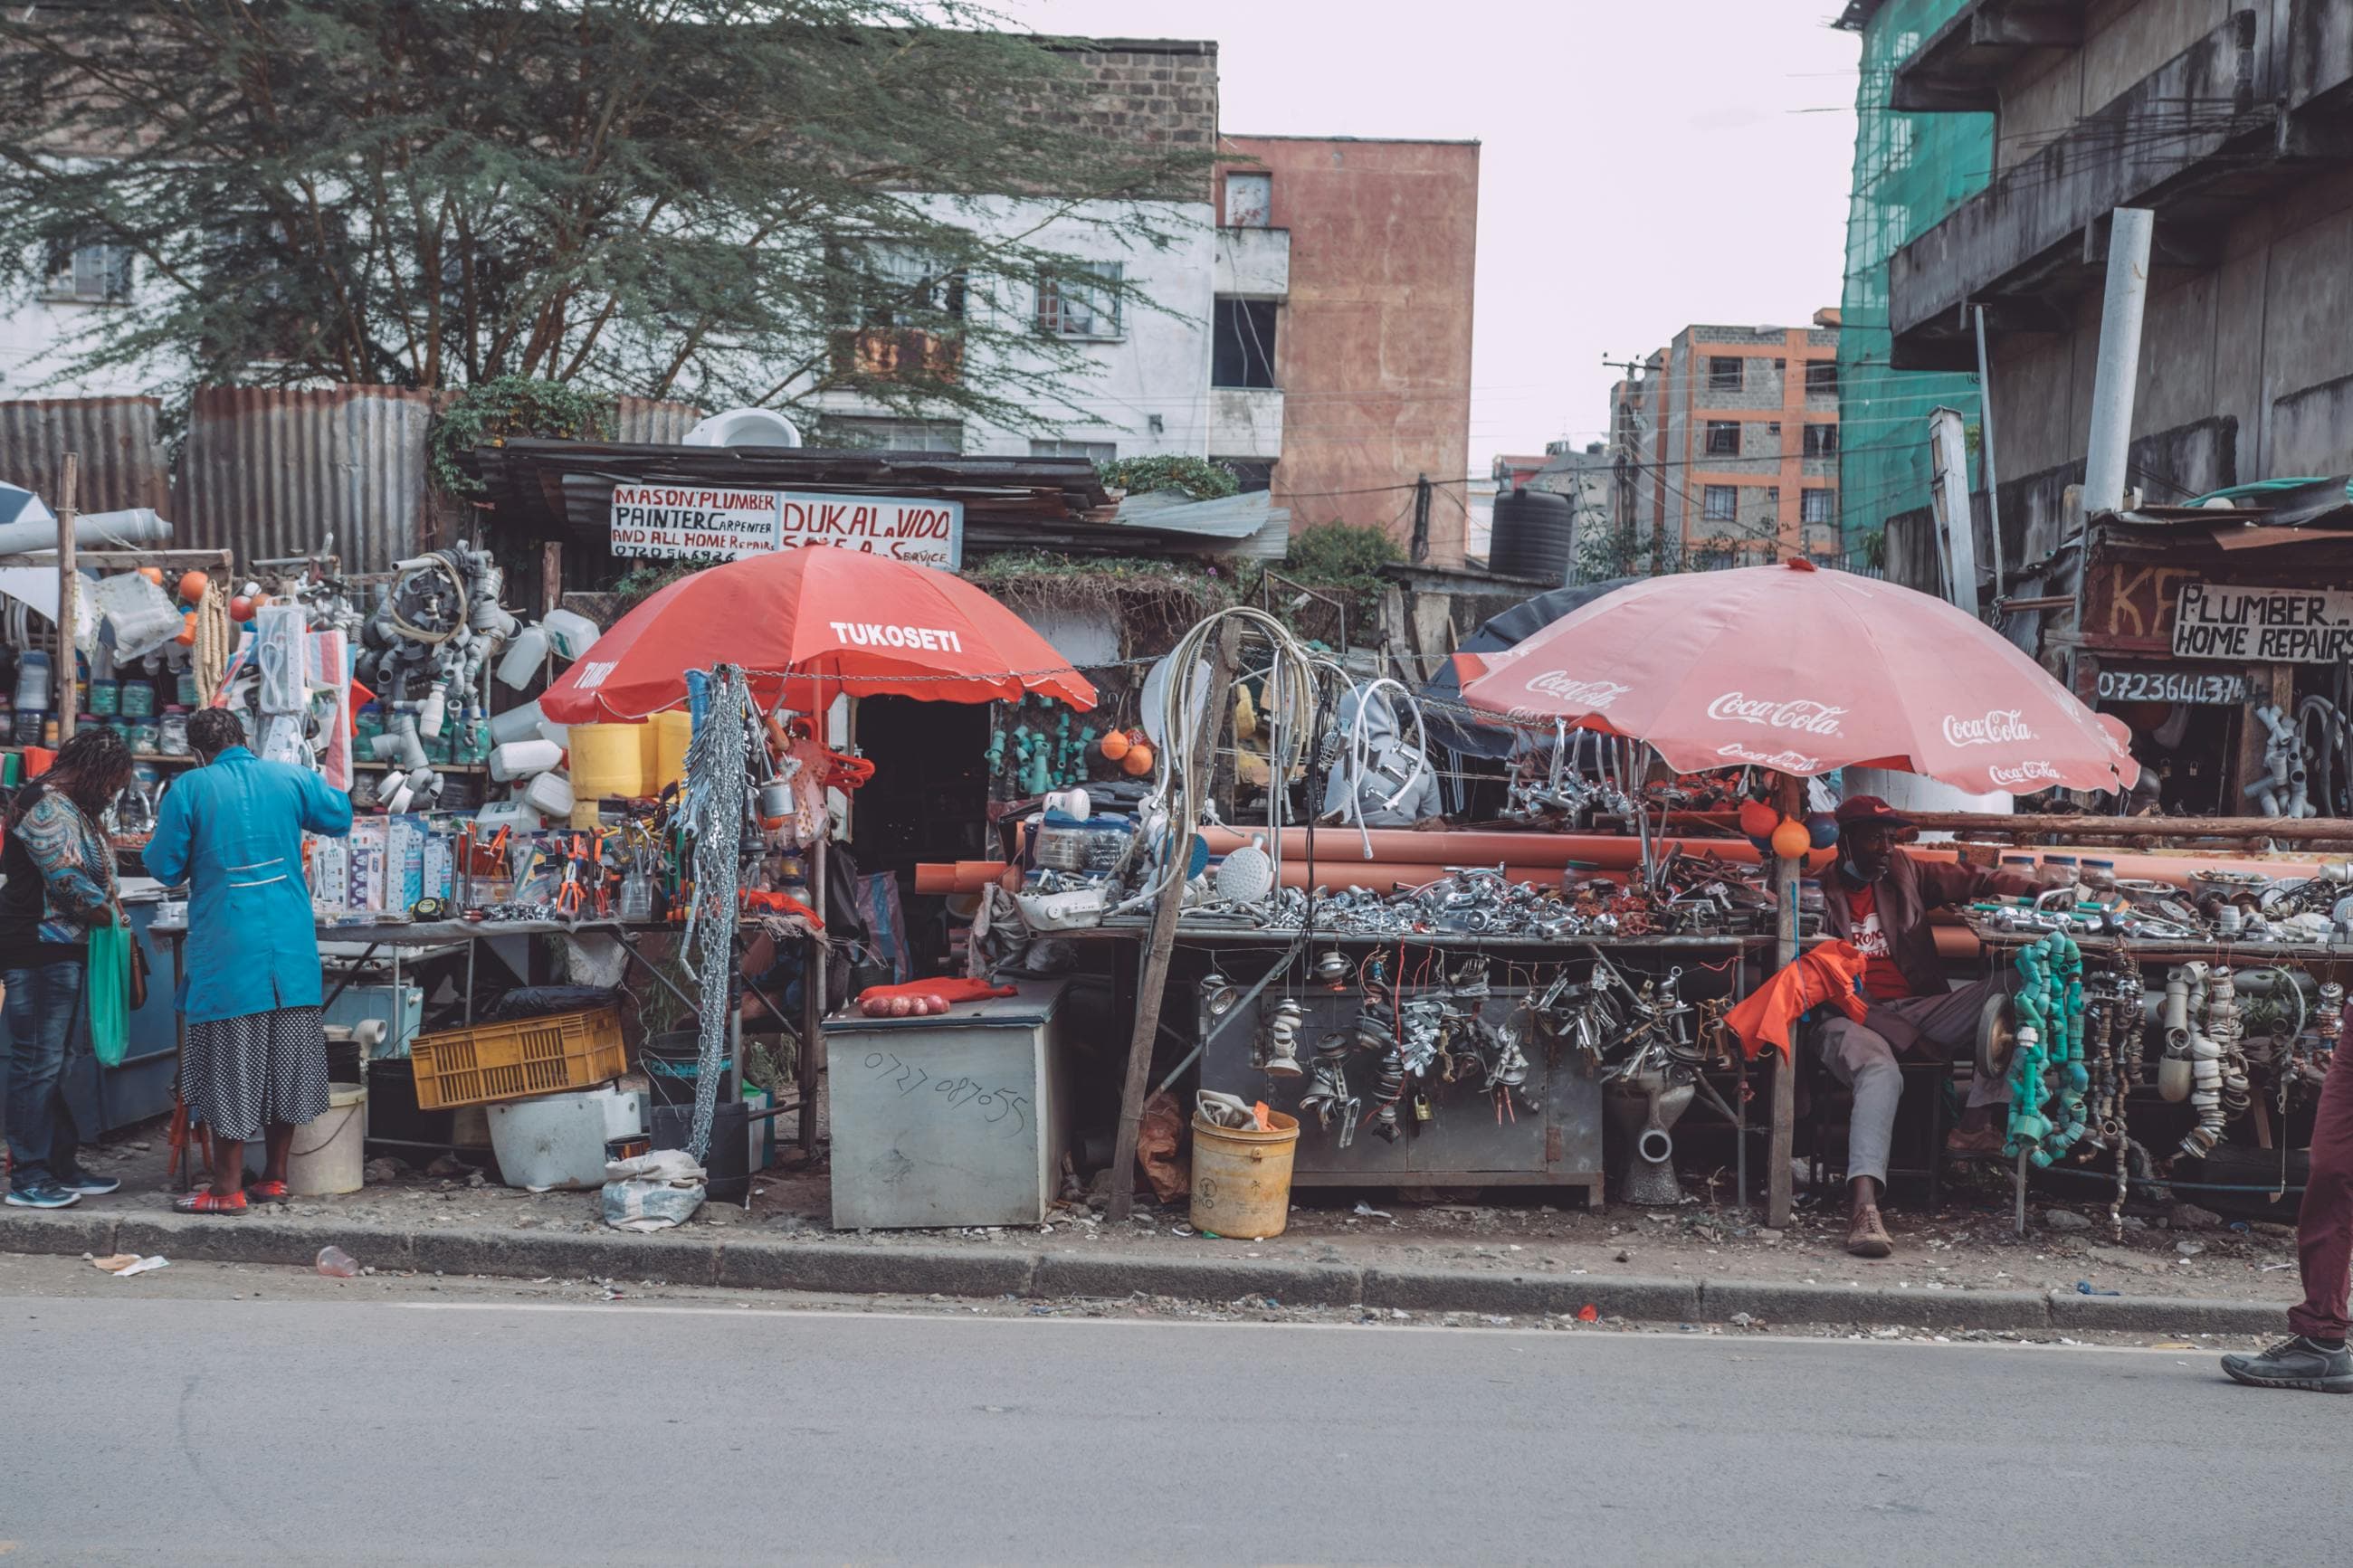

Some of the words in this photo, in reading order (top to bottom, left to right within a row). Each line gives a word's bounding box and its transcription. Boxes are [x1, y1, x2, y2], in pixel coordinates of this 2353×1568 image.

[615, 507, 705, 529] PAINTER
[707, 512, 771, 533] CARPENTER
[612, 529, 645, 543] AND
[651, 531, 680, 546] ALL
[684, 533, 725, 548] HOME
[829, 622, 962, 653] TUKOSETI
[2176, 625, 2249, 655] HOME
